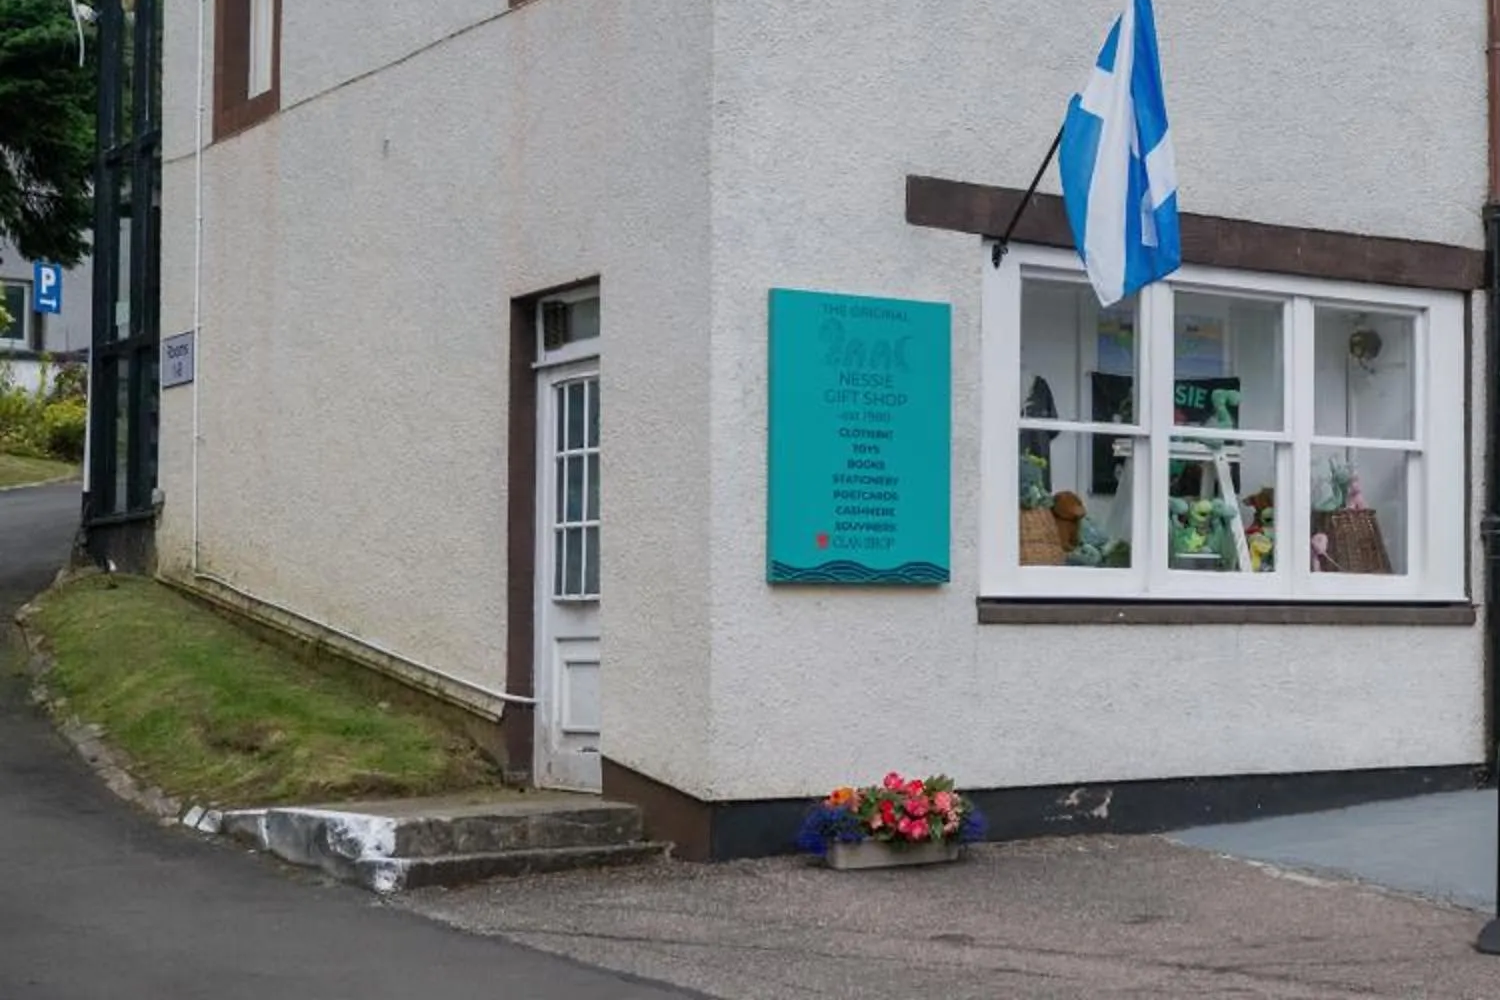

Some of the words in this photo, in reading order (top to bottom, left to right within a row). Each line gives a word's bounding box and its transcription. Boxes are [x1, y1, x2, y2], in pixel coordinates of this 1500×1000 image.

[40, 267, 56, 294] P
[821, 303, 847, 317] THE
[850, 305, 908, 321] ORIGINAL
[839, 370, 894, 389] NESSIE
[823, 388, 860, 404] GIFT
[863, 390, 908, 407] SHOP
[852, 443, 880, 454] TOYS
[846, 459, 885, 470] BOOKS
[832, 473, 899, 486] STATIONERY
[833, 489, 899, 501] POSTCARDS
[834, 505, 896, 517] CASHMERE
